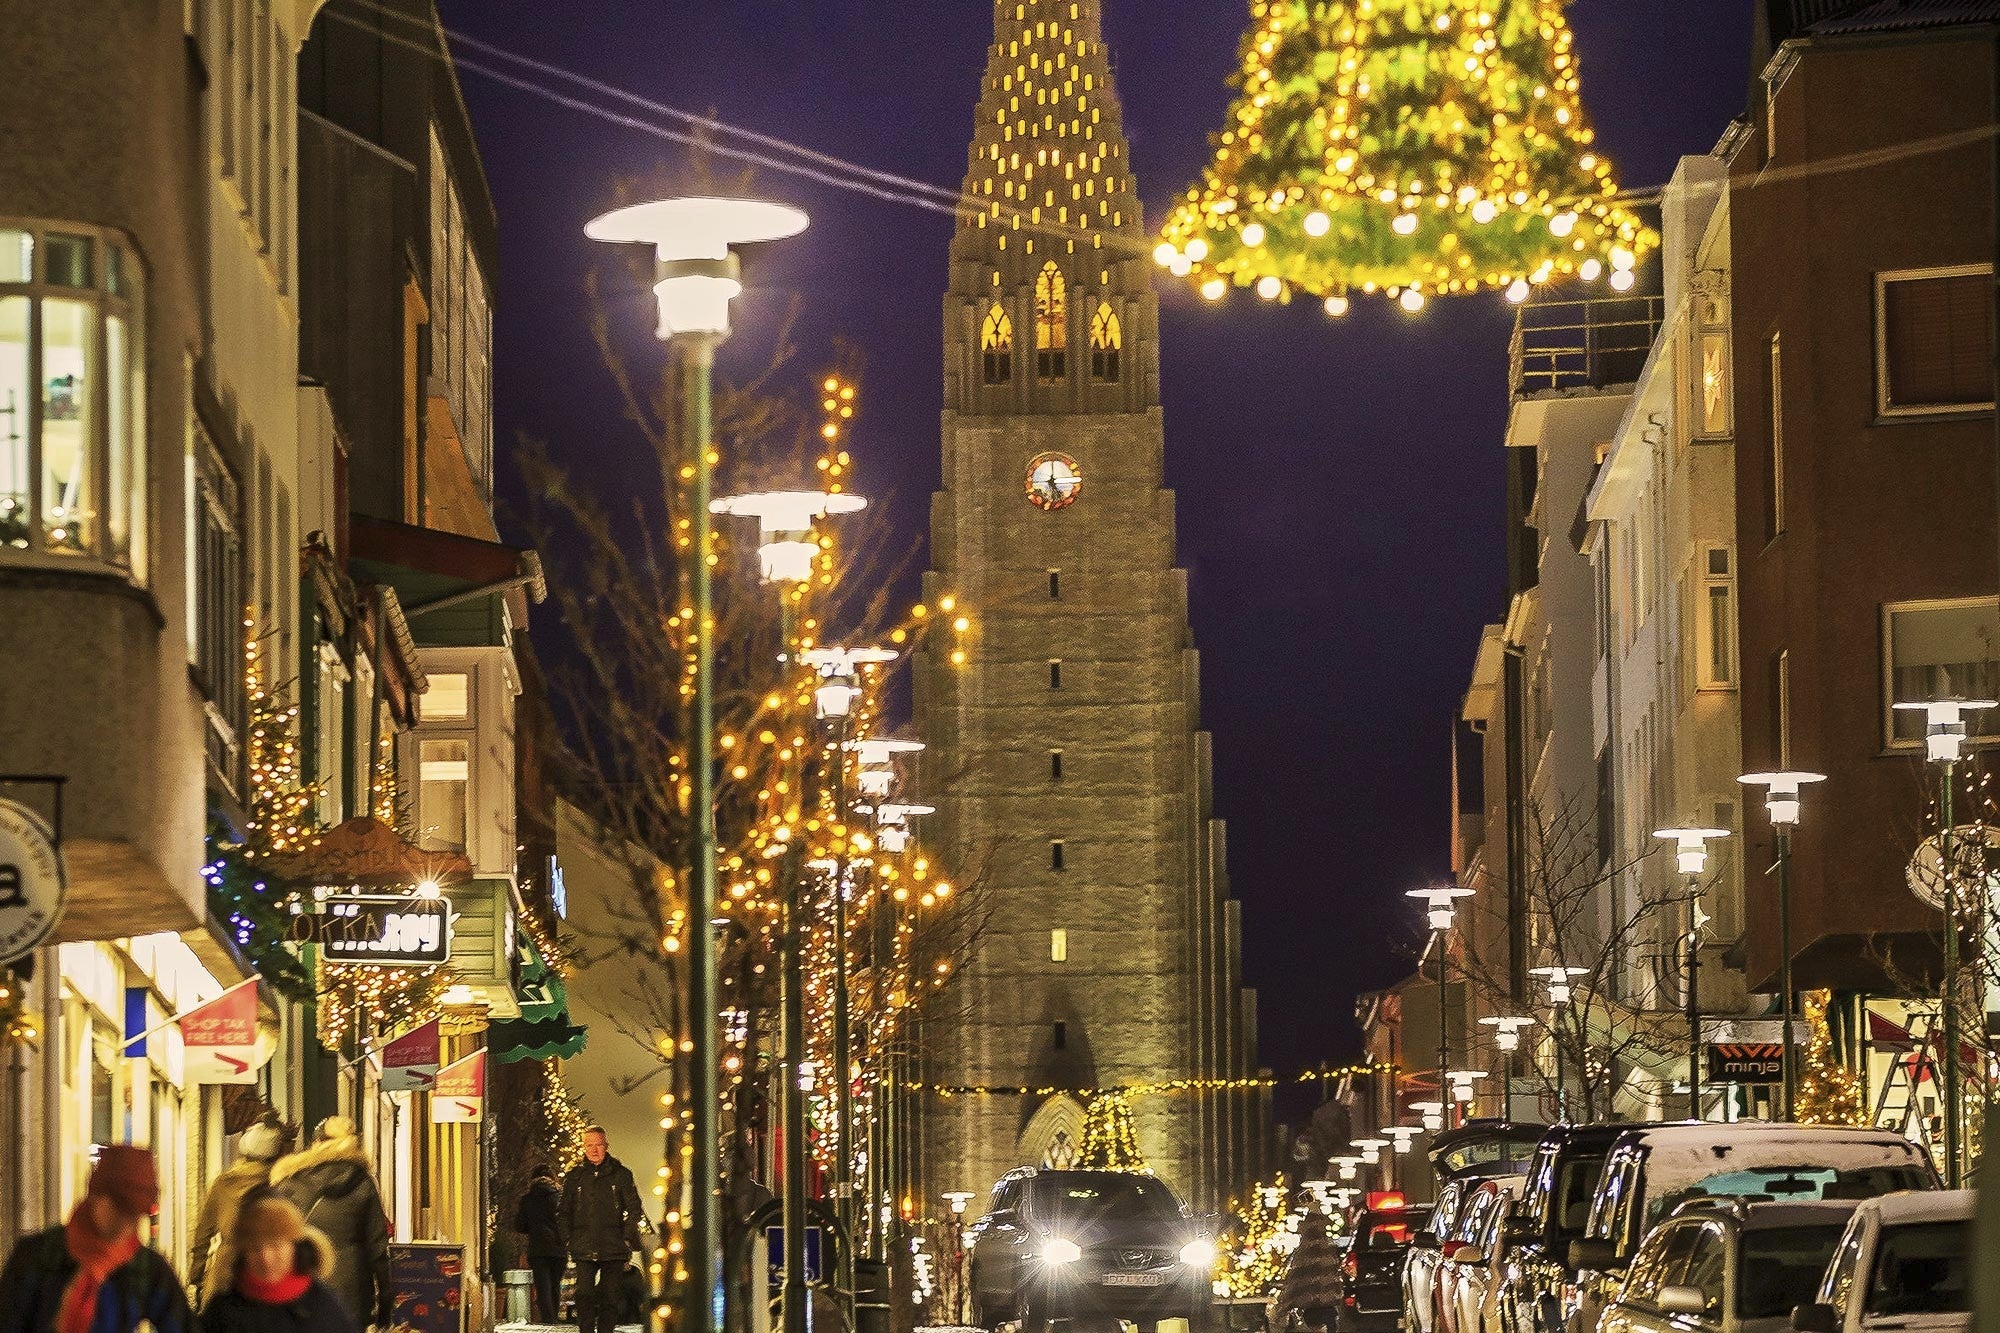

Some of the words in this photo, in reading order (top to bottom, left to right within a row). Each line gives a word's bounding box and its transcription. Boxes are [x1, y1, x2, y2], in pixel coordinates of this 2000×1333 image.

[282, 913, 381, 945] OKKA
[186, 1018, 221, 1031] SHOP
[223, 1018, 247, 1030] TAX
[1724, 1062, 1780, 1075] minja
